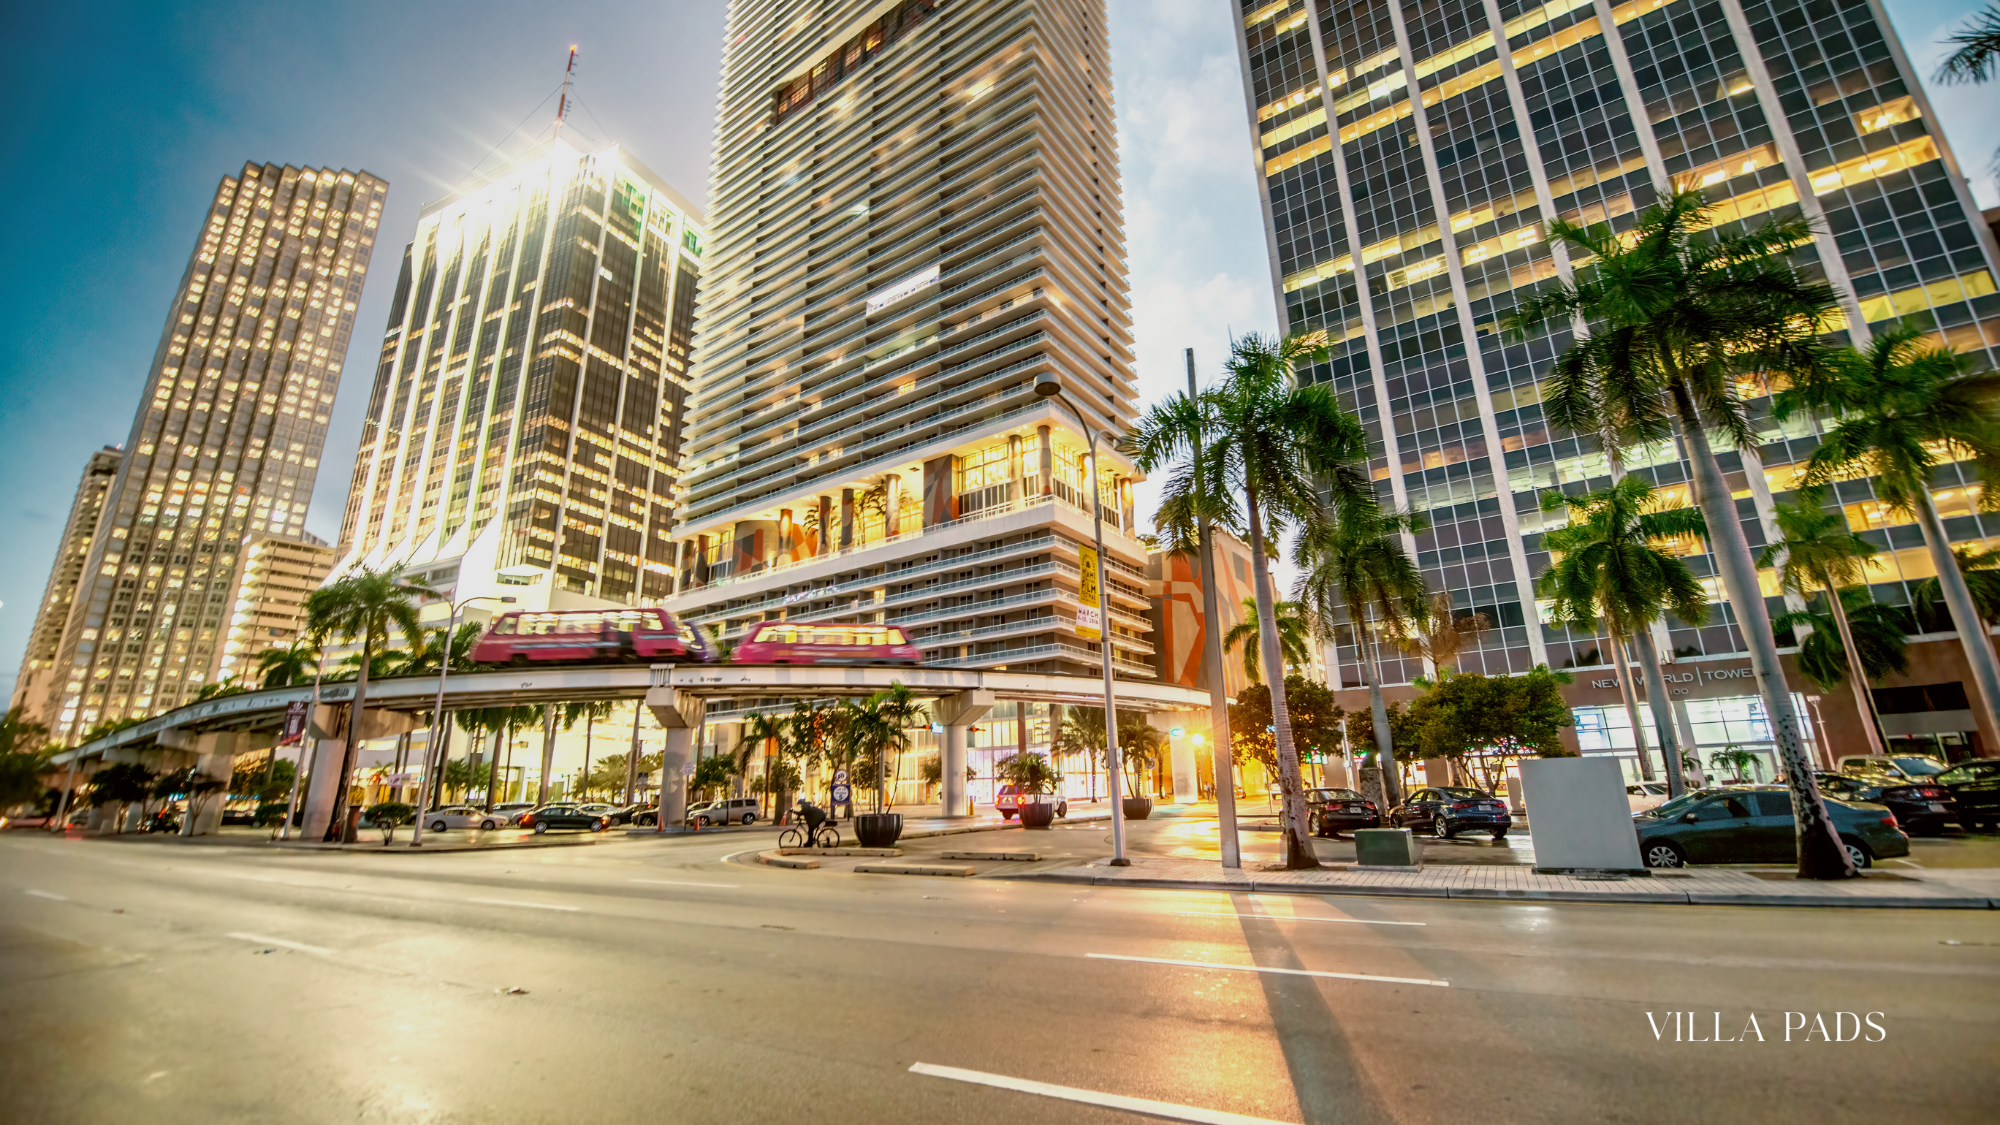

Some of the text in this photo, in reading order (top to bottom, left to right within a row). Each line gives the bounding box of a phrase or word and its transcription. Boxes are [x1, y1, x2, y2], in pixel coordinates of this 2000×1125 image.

[1081, 579, 1096, 594] FILM
[1078, 607, 1099, 619] MARCH
[1635, 673, 1694, 686] WRLD
